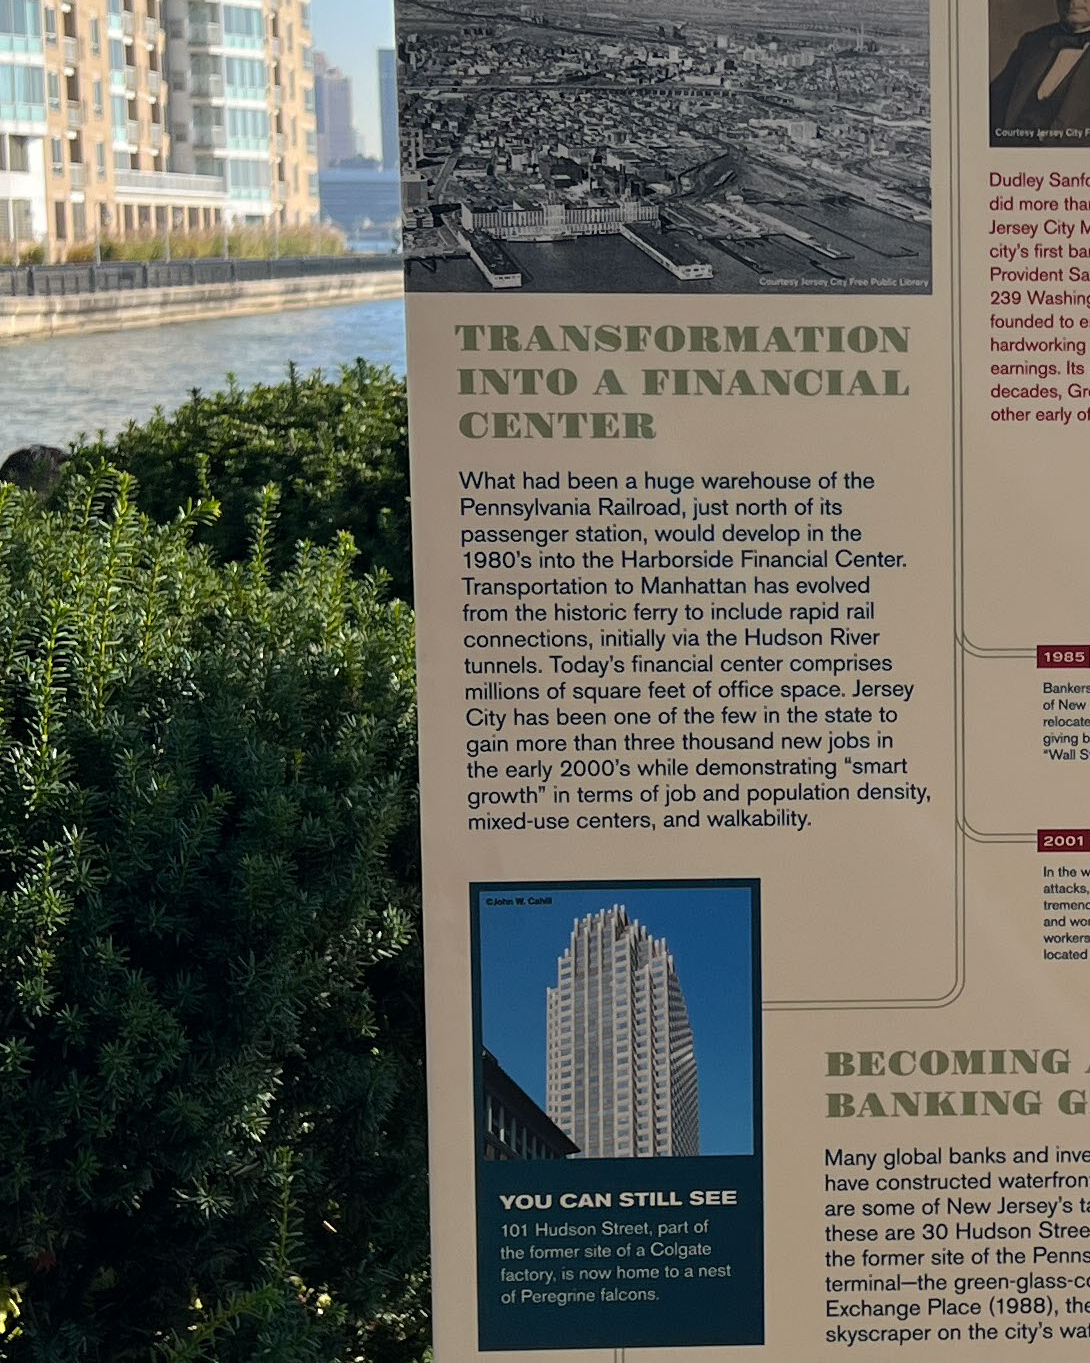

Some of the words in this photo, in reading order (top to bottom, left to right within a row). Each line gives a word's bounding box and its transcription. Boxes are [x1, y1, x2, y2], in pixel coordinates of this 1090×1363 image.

[995, 128, 1034, 137] Courtesy
[1037, 129, 1063, 138] Jersey
[1066, 128, 1082, 138] City
[990, 172, 1044, 191] Dudley
[990, 196, 1013, 210] did
[1020, 201, 1058, 211] more
[989, 220, 1038, 239] Jersey
[1044, 219, 1075, 239] City
[759, 277, 798, 287] Courtesy
[802, 278, 828, 287] Jersey
[830, 278, 847, 287] City
[849, 278, 868, 286] Free
[870, 277, 897, 286] Public
[899, 278, 928, 287] Library
[454, 325, 910, 353] TRANSFORMATION
[456, 368, 577, 395] INTO
[592, 369, 627, 395] A
[642, 369, 909, 396] FINANCIAL
[459, 412, 656, 439] CENTER
[459, 471, 515, 489] What
[523, 471, 559, 489] had
[568, 471, 618, 489] been
[626, 477, 638, 489] a
[645, 471, 694, 494] huge
[701, 471, 810, 489] warehouse
[819, 471, 837, 489] of
[844, 471, 874, 489] the
[1044, 652, 1084, 662] 1985
[1043, 699, 1055, 710] of
[1059, 699, 1086, 710] New
[1044, 836, 1083, 846] 2001
[1044, 866, 1054, 877] In
[1058, 866, 1077, 877] the
[825, 1049, 1071, 1077] BECOMING
[826, 1090, 1042, 1117] BANKING
[826, 1149, 877, 1170] Many
[884, 1147, 941, 1170] global
[950, 1147, 1006, 1164] banks
[1013, 1146, 1048, 1163] and
[500, 1195, 552, 1209] YOU
[560, 1193, 611, 1208] CAN
[619, 1192, 682, 1207] STILL
[690, 1191, 737, 1205] SEE
[502, 1224, 526, 1237] 101
[536, 1223, 596, 1236] Hudson
[602, 1221, 652, 1235] Street,
[658, 1221, 688, 1237] part
[694, 1219, 708, 1233] of
